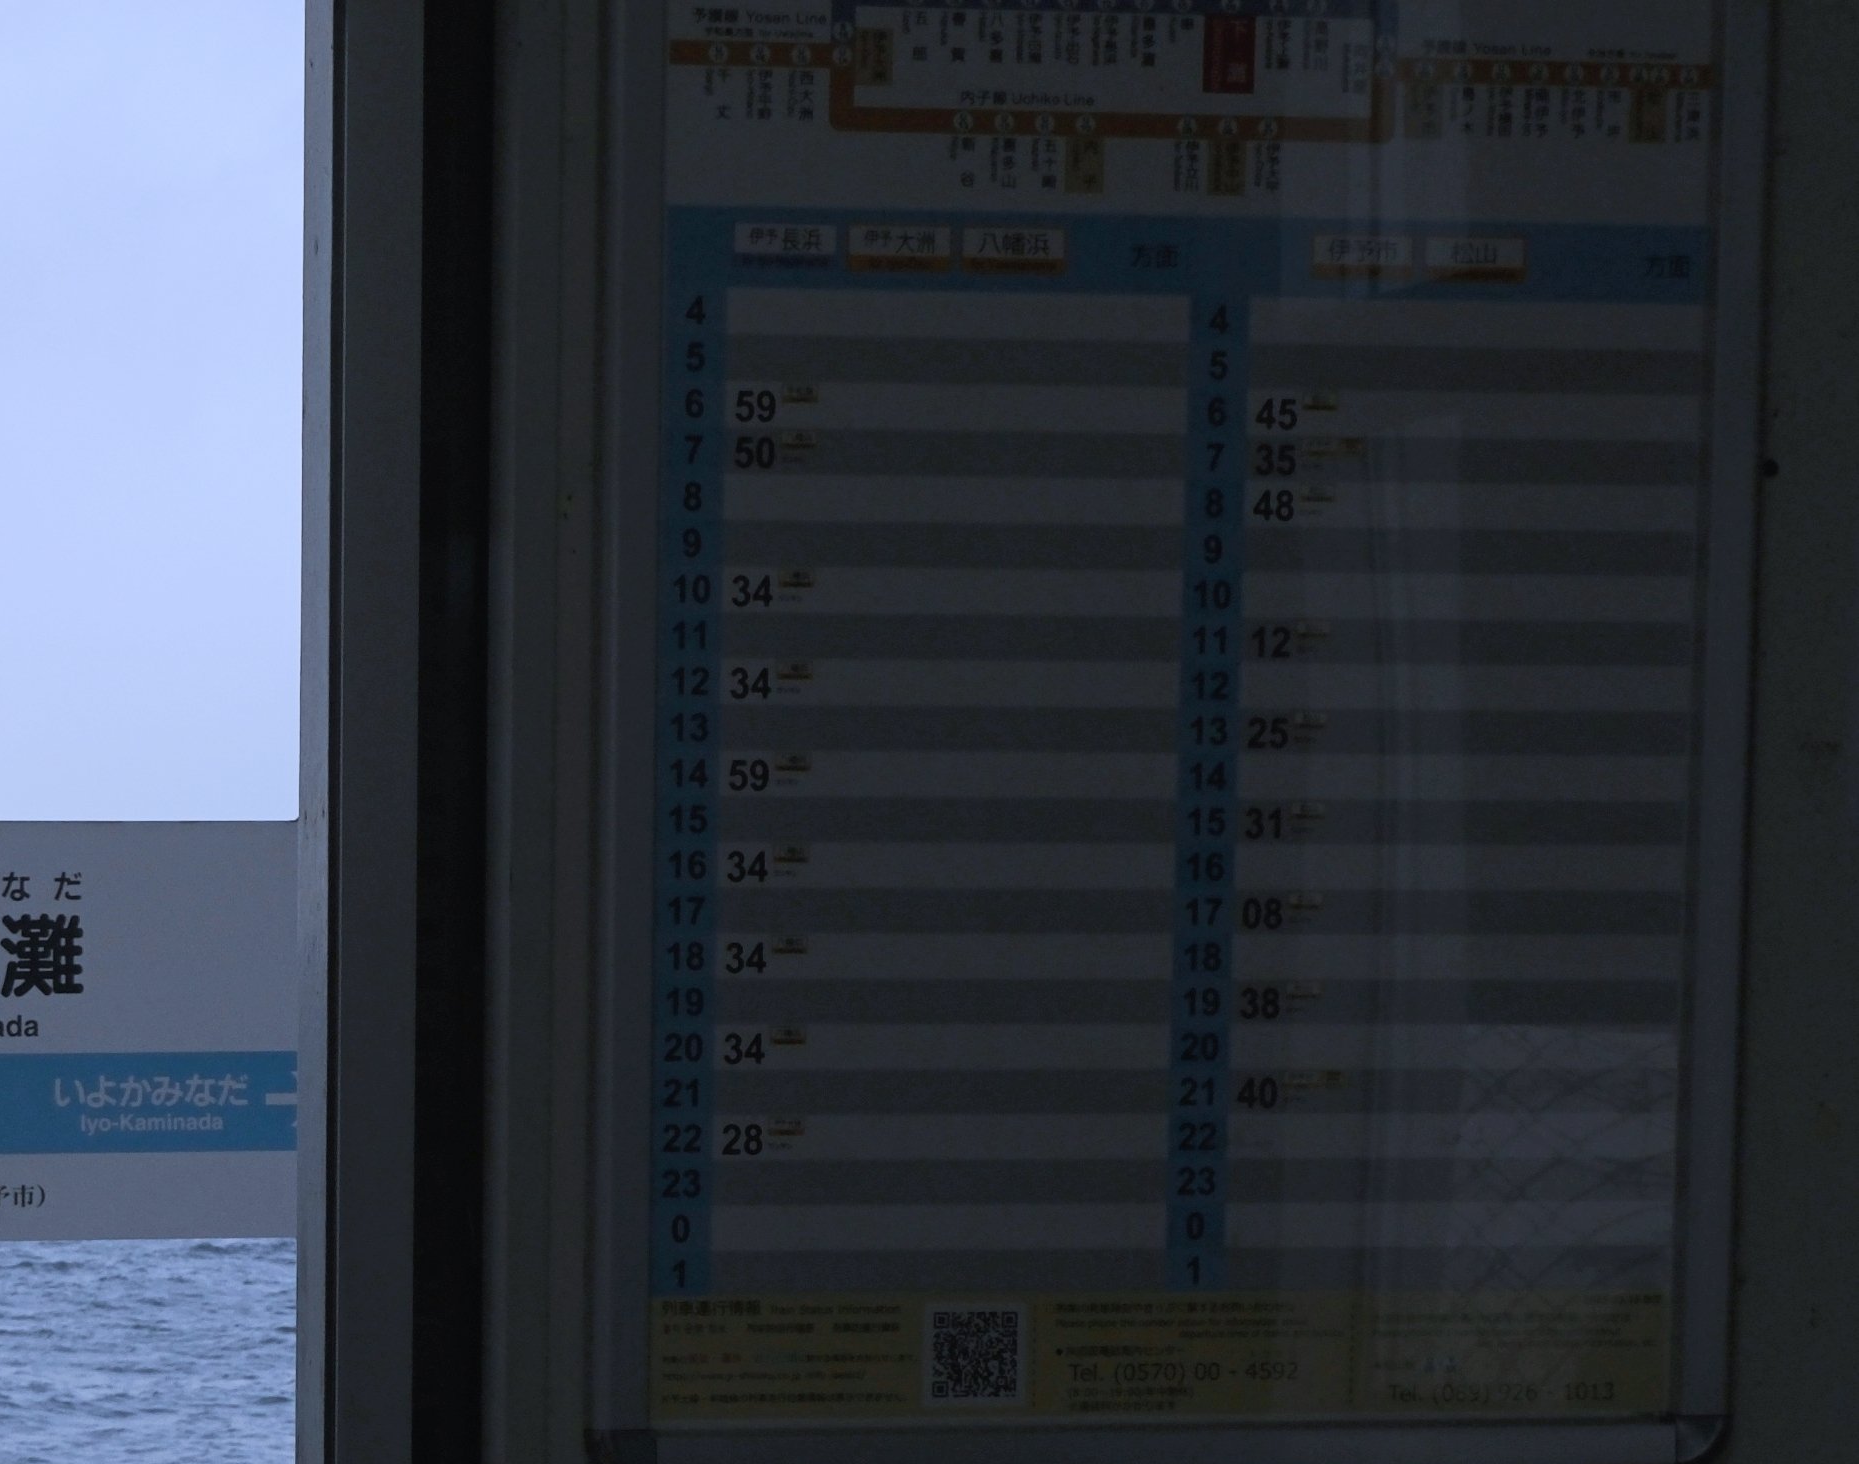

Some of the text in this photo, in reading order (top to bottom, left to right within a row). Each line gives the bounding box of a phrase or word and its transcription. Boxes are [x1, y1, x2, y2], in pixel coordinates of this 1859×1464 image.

[796, 11, 828, 25] Line
[1064, 94, 1096, 107] Line
[748, 227, 822, 252] 伊予長浜
[863, 229, 936, 254] 伊予大洲
[978, 233, 1051, 257] 八幡浜
[1451, 241, 1498, 266] 松山
[1129, 244, 1180, 270] 方面
[684, 295, 706, 325] 4
[1209, 305, 1229, 334] 4
[685, 342, 706, 372] 5
[1209, 351, 1228, 381] 5
[684, 388, 705, 419] 6
[735, 389, 776, 422] 59
[1207, 397, 1226, 427] 6
[1255, 398, 1298, 430] 45
[684, 435, 704, 464] 7
[734, 436, 776, 468] 50
[1206, 443, 1225, 472] 7
[1254, 444, 1297, 477] 35
[683, 481, 702, 511] 8
[1204, 489, 1224, 518] 8
[1253, 490, 1295, 522] 48
[682, 528, 702, 558] 9
[1203, 535, 1223, 564] 9
[673, 575, 712, 604] 10
[731, 575, 773, 607] 34
[1194, 581, 1231, 610] 10
[672, 621, 707, 650] 11
[1193, 627, 1228, 655] 11
[1251, 627, 1291, 659] 12
[671, 667, 710, 696] 12
[730, 668, 771, 700] 34
[1192, 672, 1230, 701] 12
[670, 713, 709, 742] 13
[1191, 717, 1229, 746] 13
[1247, 717, 1289, 750] 25
[670, 759, 708, 788] 14
[729, 759, 770, 791] 59
[1190, 762, 1228, 791] 14
[668, 805, 708, 834] 15
[1188, 808, 1227, 837] 15
[1245, 808, 1284, 840] 31
[668, 850, 707, 880] 16
[726, 850, 768, 882] 34
[1187, 853, 1225, 882] 16
[667, 896, 705, 925] 17
[1185, 898, 1223, 927] 17
[1242, 898, 1283, 930] 08
[666, 942, 705, 971] 18
[725, 942, 767, 974] 34
[1184, 943, 1222, 971] 18
[666, 988, 704, 1017] 19
[1184, 988, 1281, 1020] 19 38
[664, 1033, 703, 1062] 20
[723, 1033, 765, 1065] 34
[1180, 1033, 1219, 1062] 20
[53, 1073, 249, 1109] いよかみなだ
[663, 1079, 700, 1107] 21
[1179, 1077, 1278, 1109] 21 40
[80, 1112, 224, 1135] Iyo-Kaminada
[1178, 1122, 1217, 1152] 22
[662, 1124, 702, 1153] 22
[722, 1124, 764, 1156] 28
[662, 1170, 702, 1199] 23
[1177, 1167, 1216, 1196] 23
[671, 1215, 691, 1244] 0
[1185, 1212, 1204, 1241] 0
[672, 1260, 686, 1288] 1
[1187, 1256, 1200, 1285] 1
[1069, 1364, 1105, 1383] Tel.
[1113, 1362, 1186, 1386] (0570)
[1193, 1364, 1221, 1382] 00
[1244, 1362, 1299, 1382] 4592
[1563, 1382, 1616, 1403] 1013
